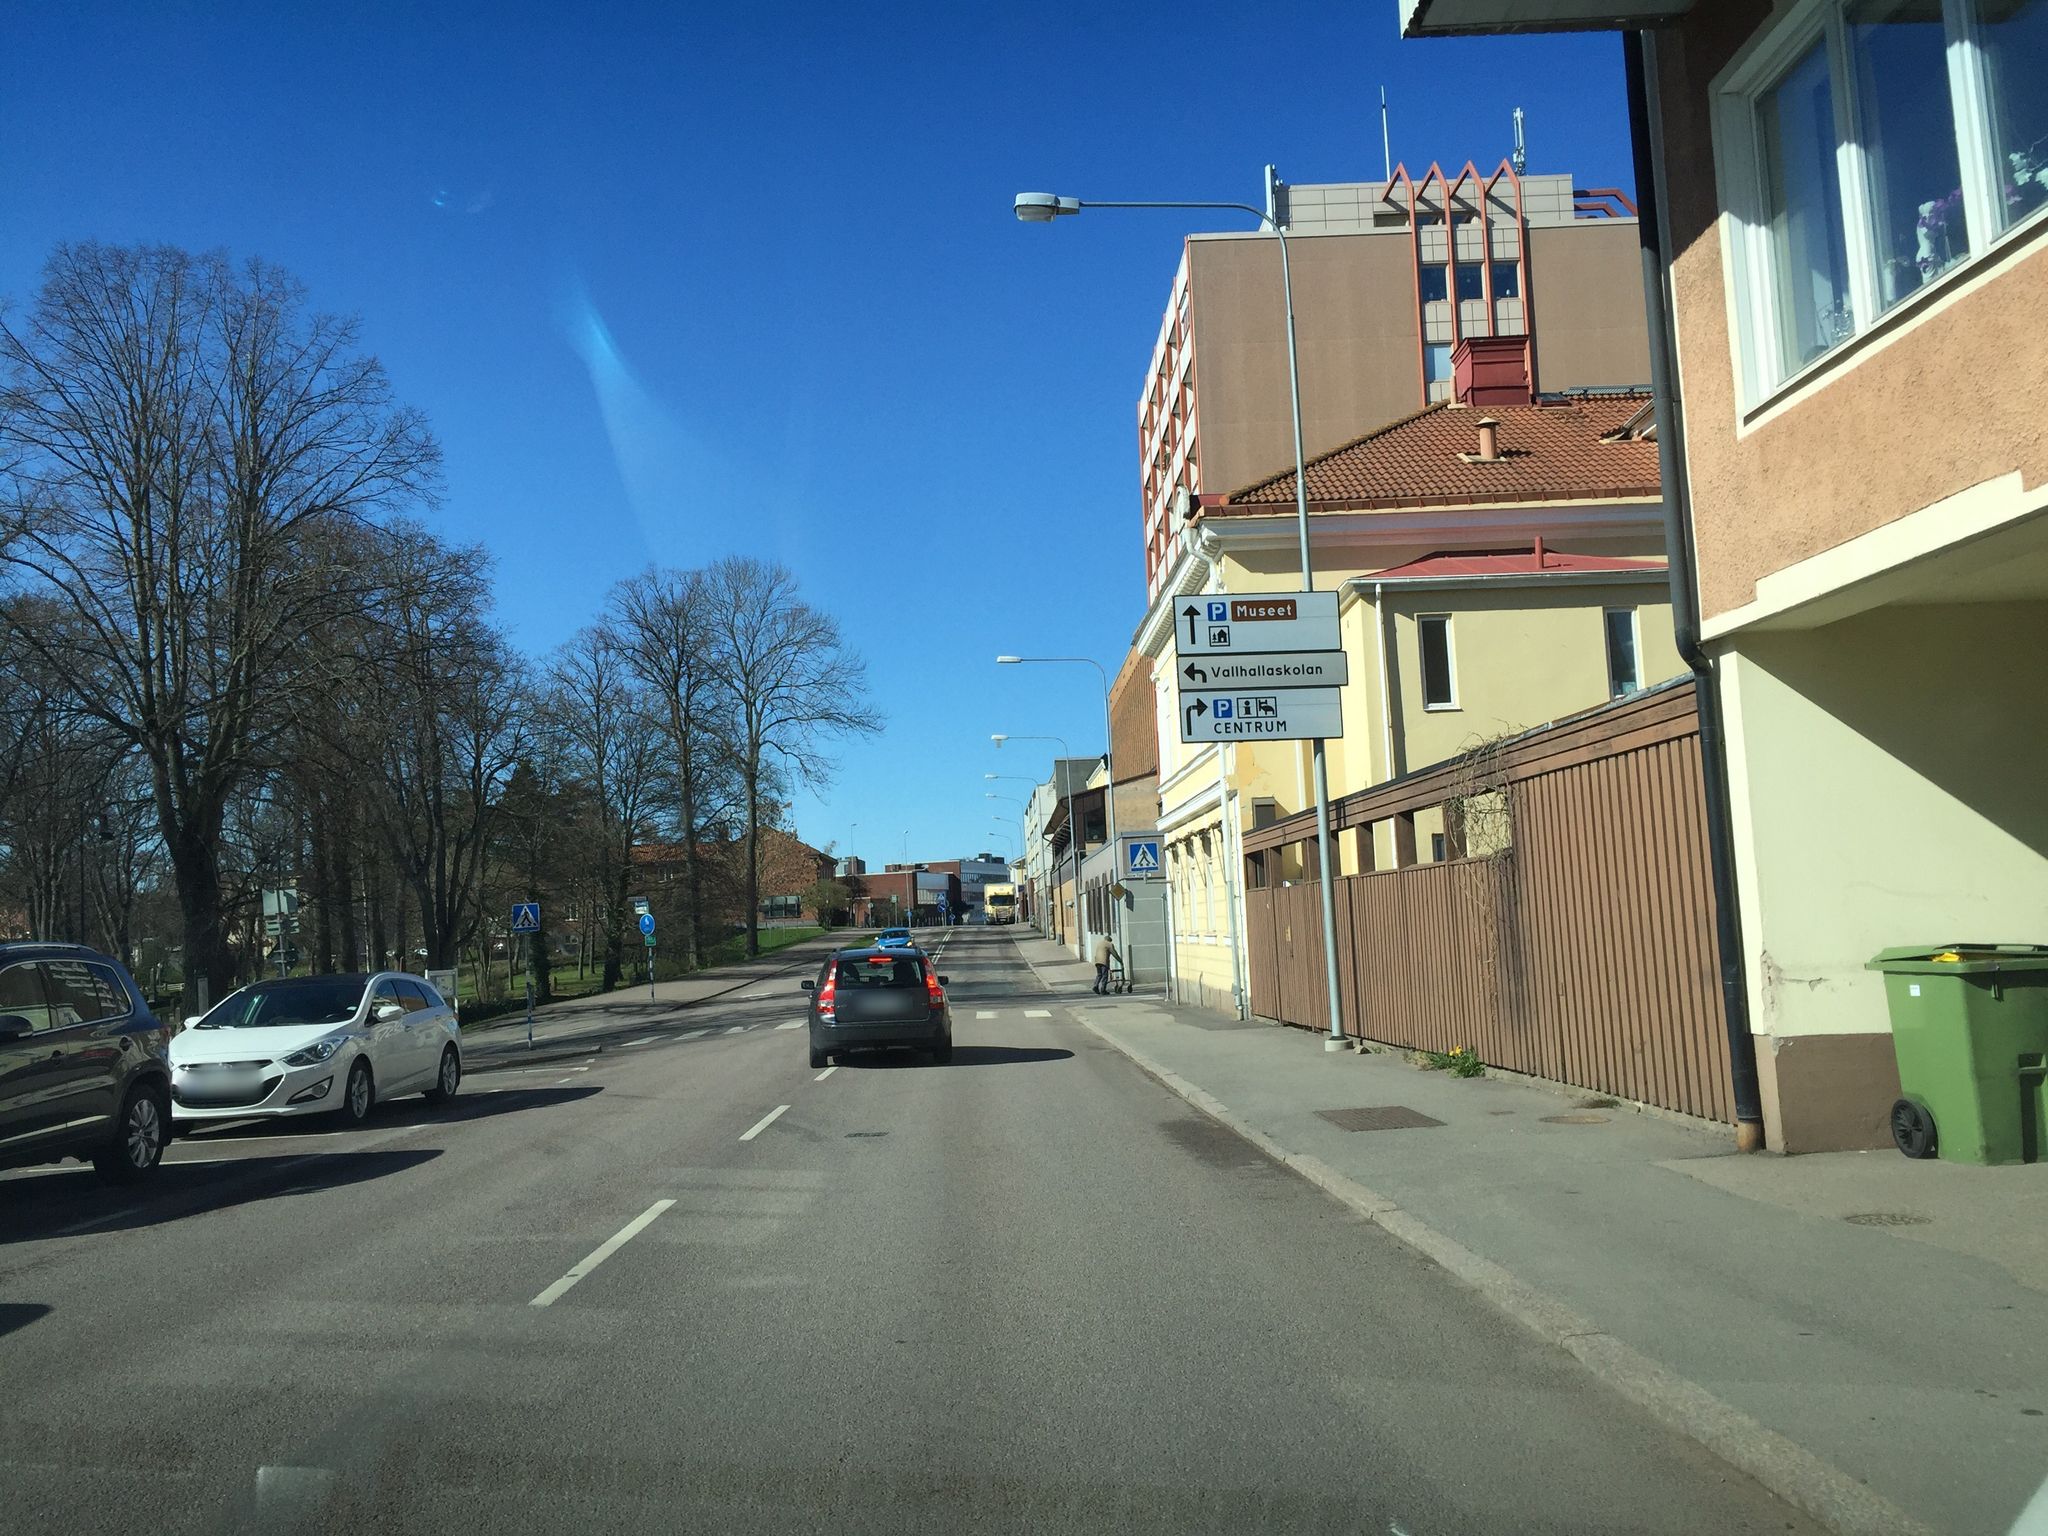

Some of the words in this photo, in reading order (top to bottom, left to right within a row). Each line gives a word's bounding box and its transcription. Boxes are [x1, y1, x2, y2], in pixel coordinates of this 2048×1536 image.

[1213, 605, 1224, 620] P
[1237, 604, 1292, 618] Museet
[1211, 664, 1323, 678] Vallhallaskolan
[1218, 701, 1230, 717] P
[1213, 720, 1287, 734] CENTRUM
